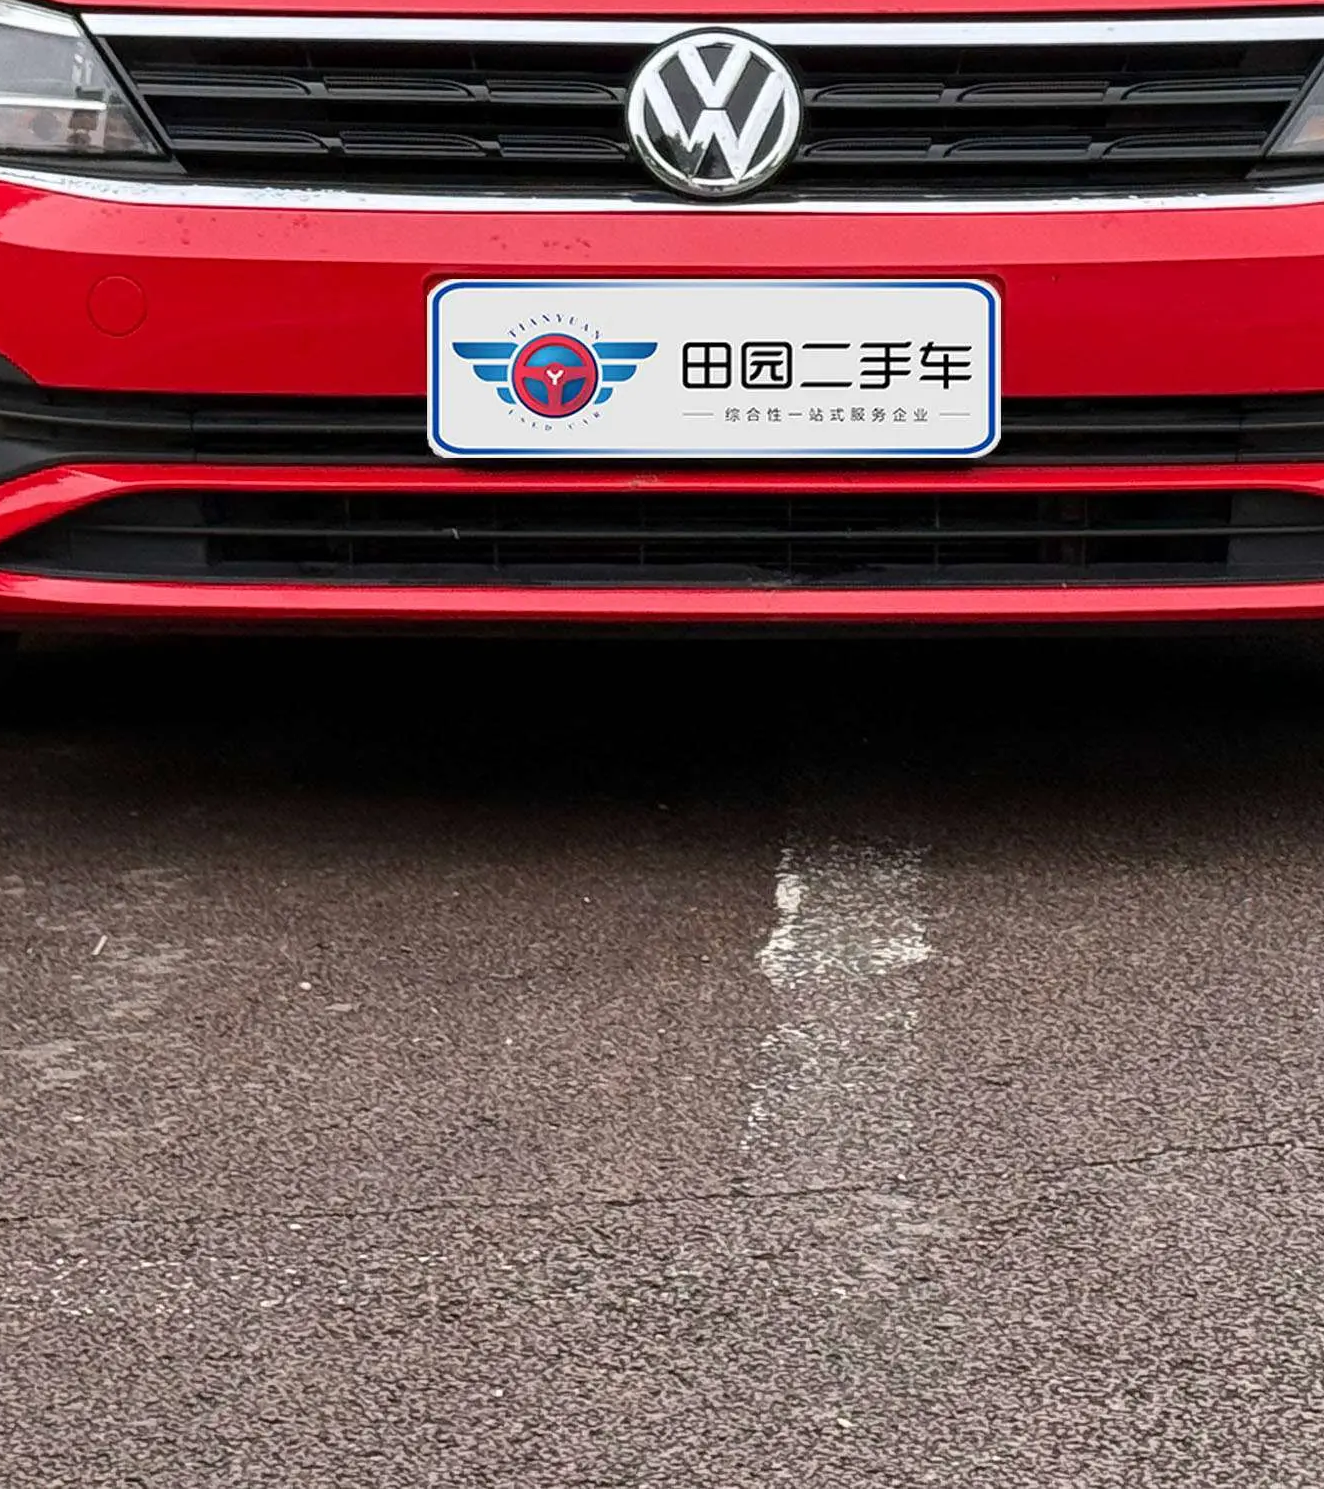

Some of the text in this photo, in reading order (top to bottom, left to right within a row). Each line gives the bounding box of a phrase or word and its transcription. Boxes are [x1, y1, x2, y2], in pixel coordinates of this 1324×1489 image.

[638, 40, 788, 184] VW
[545, 369, 565, 386] Y
[682, 341, 973, 390] 田园二手车
[724, 406, 928, 423] 综合性一站式服务企业
